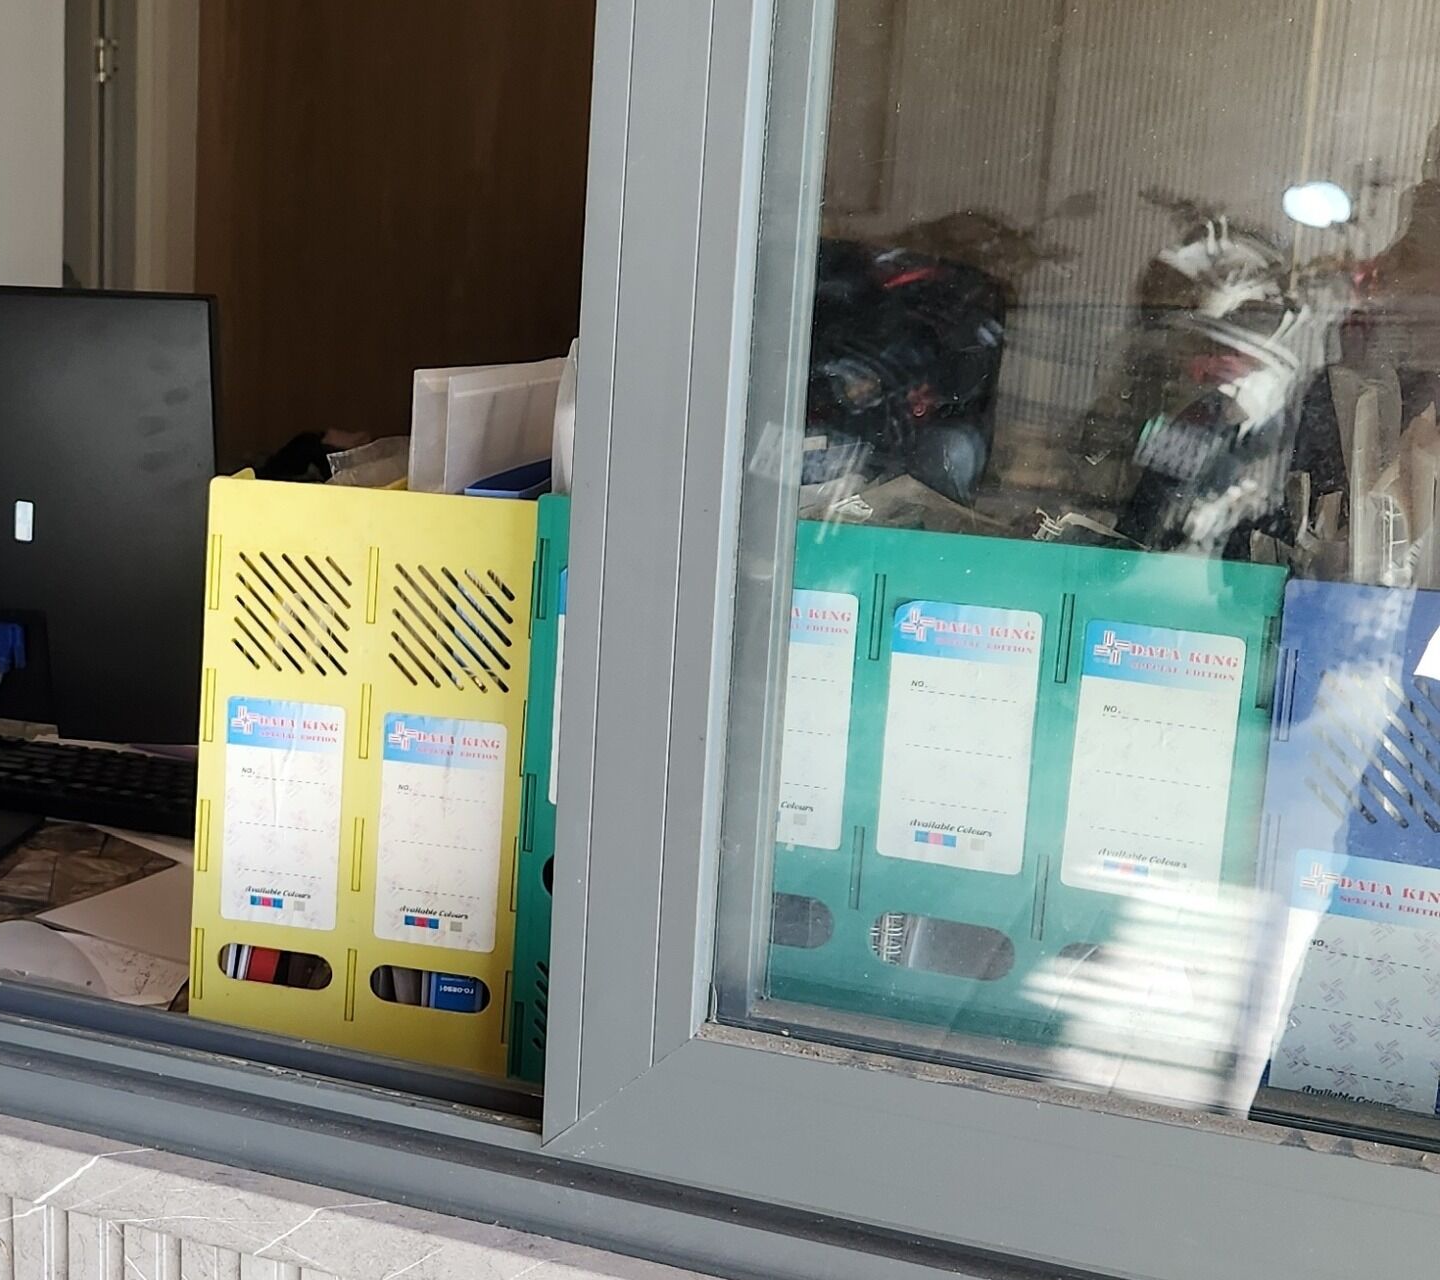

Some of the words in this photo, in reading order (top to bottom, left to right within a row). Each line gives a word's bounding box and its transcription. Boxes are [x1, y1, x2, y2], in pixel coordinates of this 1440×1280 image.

[809, 608, 851, 622] KING
[936, 621, 981, 635] DATA
[990, 626, 1036, 641] KING
[987, 643, 1033, 654] EDITION
[1131, 644, 1179, 660] DATA
[1190, 652, 1239, 668] KING
[1186, 668, 1235, 681] EDITION
[259, 715, 295, 728] DATA
[303, 719, 339, 732] KING
[417, 731, 455, 745] DATA
[462, 736, 500, 749] KING
[909, 819, 956, 832] Available
[957, 825, 993, 838] Colours
[1340, 877, 1392, 896] DATA
[1402, 887, 1440, 904] KIN
[438, 910, 469, 920] Colours
[1340, 895, 1392, 909] SPECIAL
[1398, 904, 1440, 918] EDITIO
